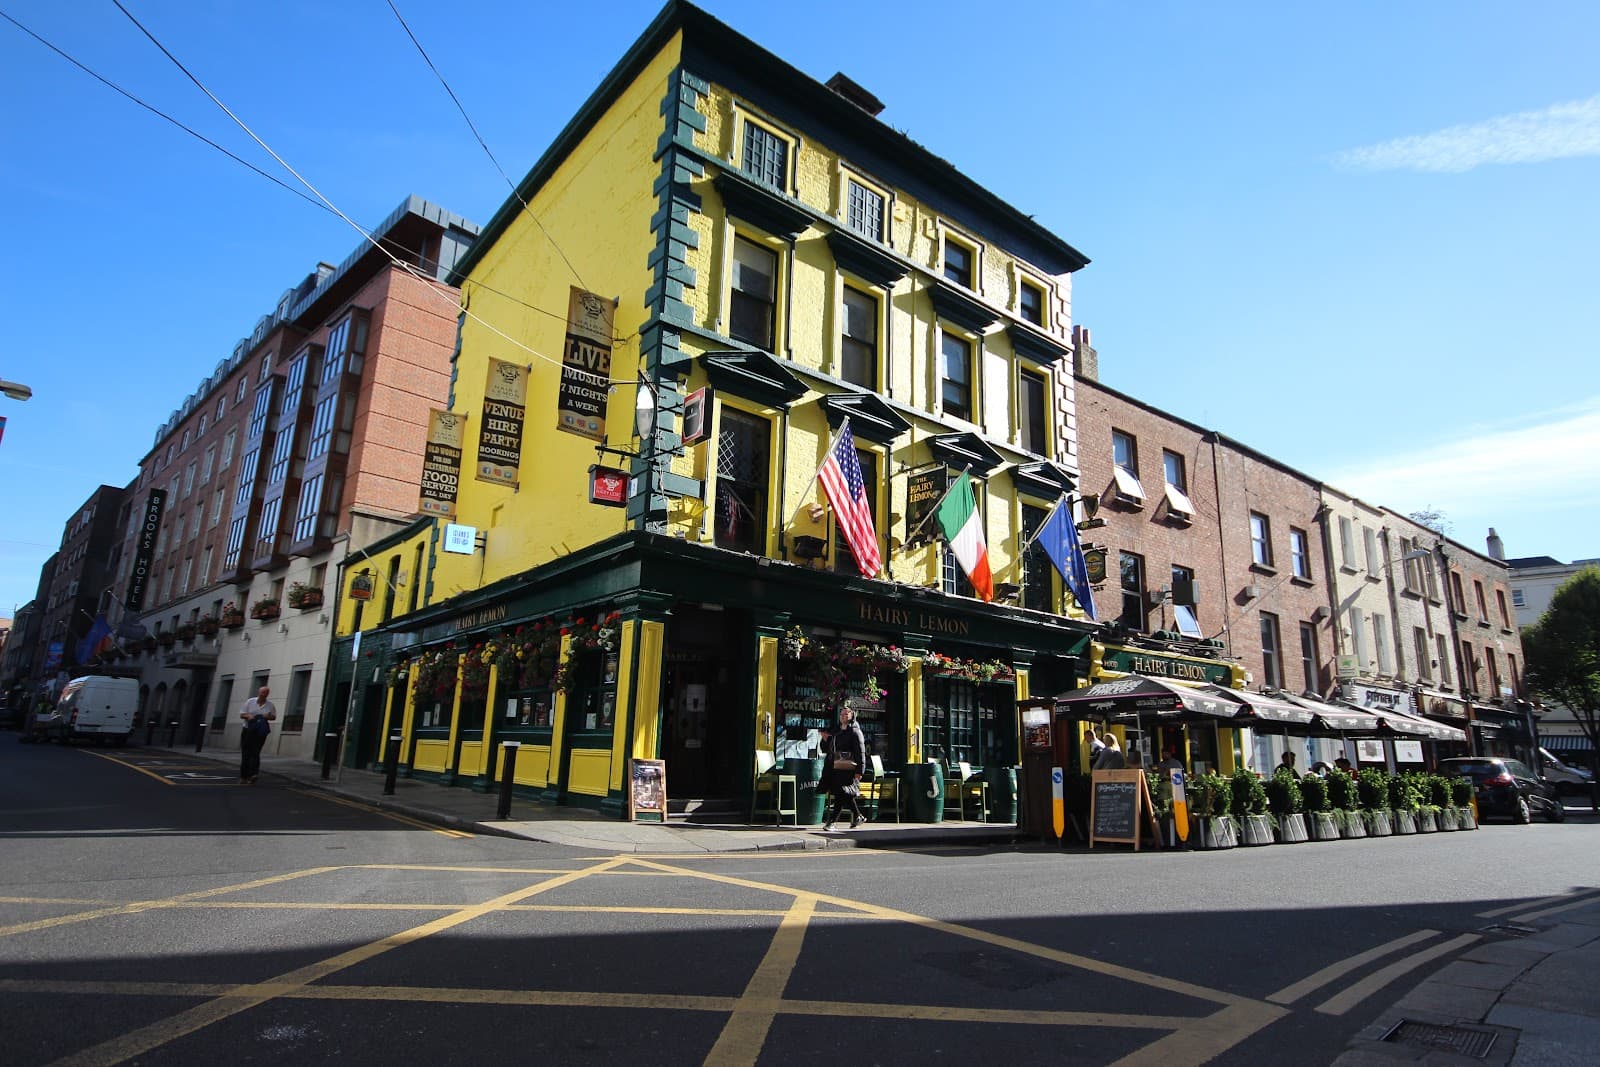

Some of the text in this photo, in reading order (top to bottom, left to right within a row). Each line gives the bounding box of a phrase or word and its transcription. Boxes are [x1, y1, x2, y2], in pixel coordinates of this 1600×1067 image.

[565, 338, 611, 373] LIVE
[563, 367, 607, 387] MUSIC
[560, 382, 608, 403] 7 NIGHTS
[484, 402, 525, 420] VENUE
[574, 400, 599, 413] WEEK
[488, 419, 518, 434] HIRE
[483, 432, 520, 448] PARTY
[479, 445, 519, 459] BOOKINGS
[423, 470, 457, 485] FOOD
[421, 480, 457, 493] SERVED
[910, 481, 934, 494] HAIRY
[439, 491, 452, 500] DAY
[910, 491, 934, 503] LEMON
[131, 496, 161, 604] BROOKS HOTEL
[455, 604, 506, 632] HAIRY LEMON
[859, 602, 970, 636] HAIRY LEMON
[1134, 657, 1207, 680] HAIRY LEMON
